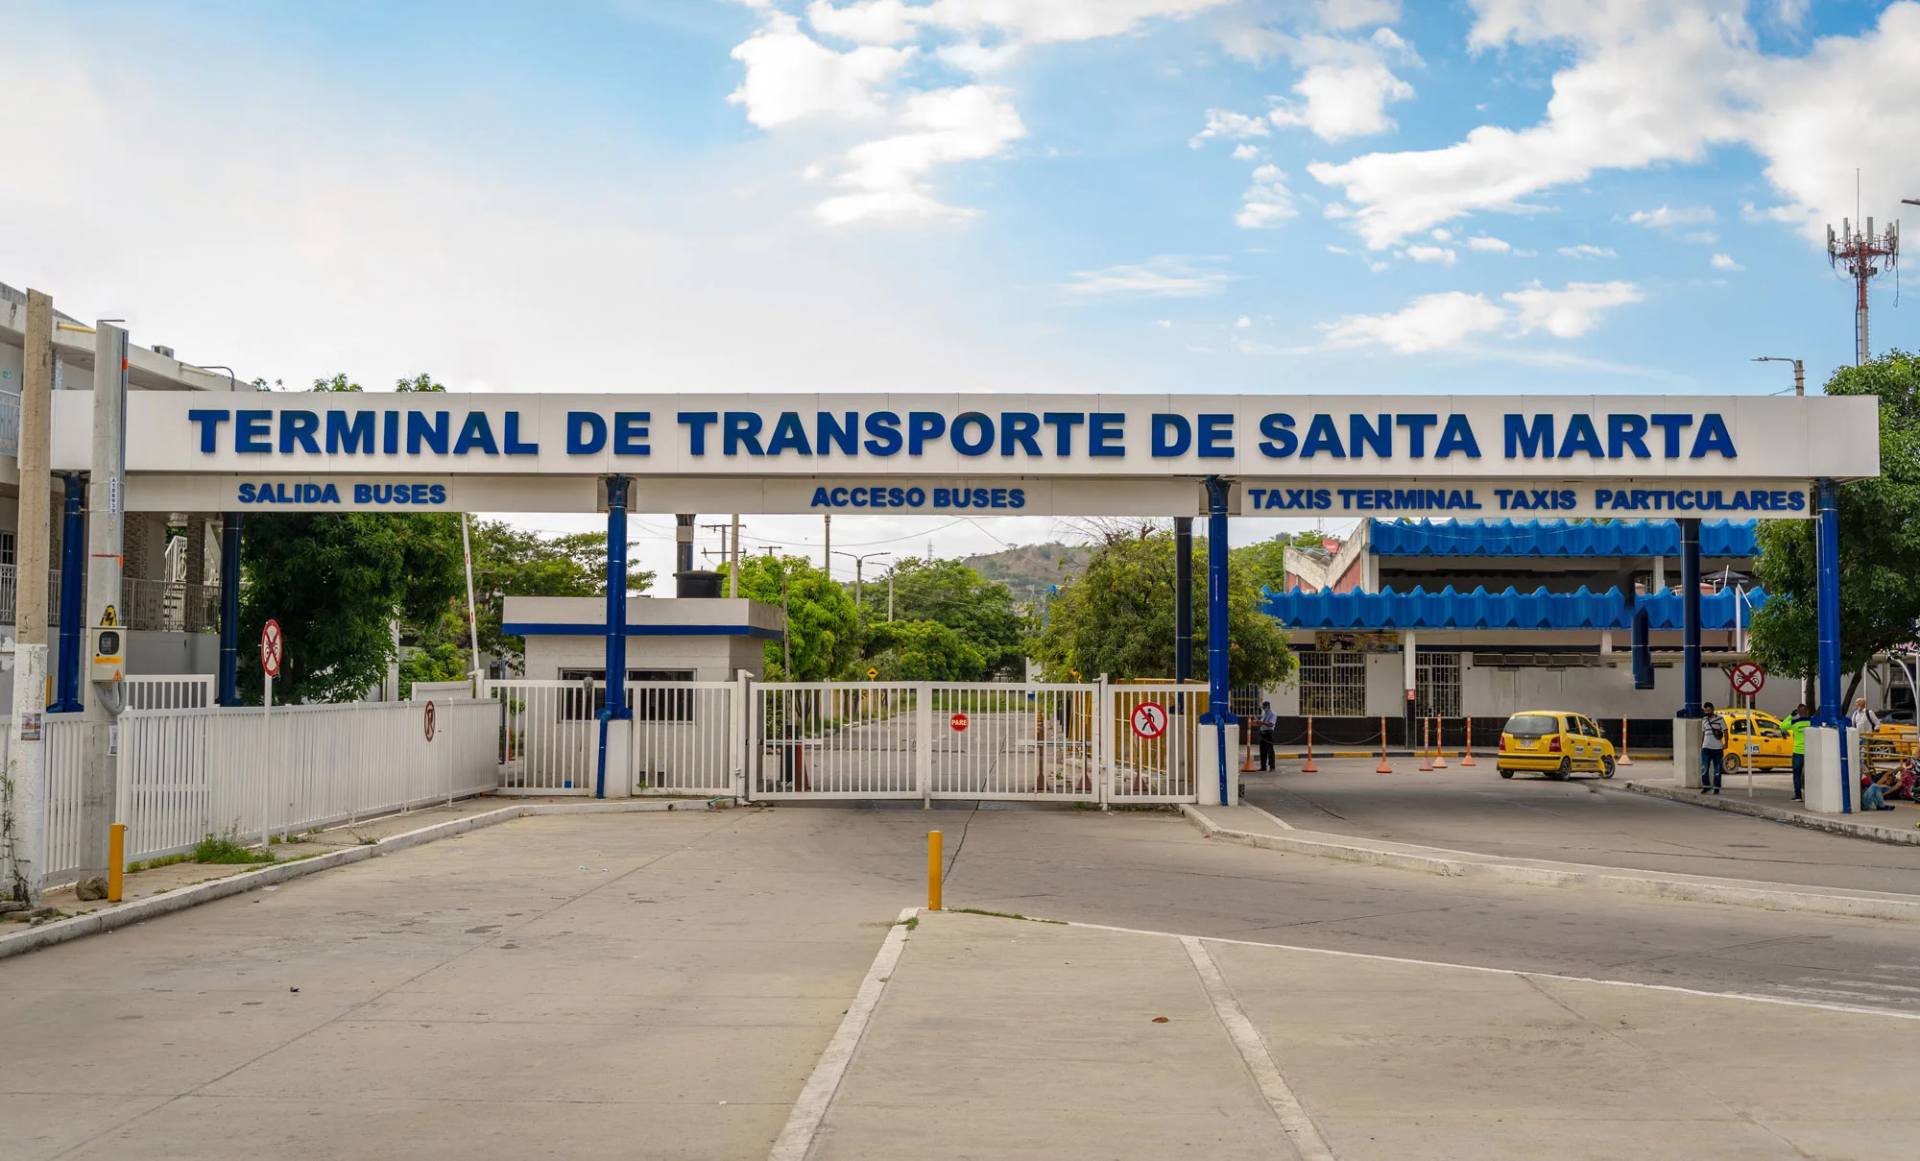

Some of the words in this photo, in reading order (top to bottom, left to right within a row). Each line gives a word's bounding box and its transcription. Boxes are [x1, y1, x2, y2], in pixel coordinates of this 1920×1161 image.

[187, 409, 539, 455] TERMINAL
[566, 411, 651, 456] DE
[677, 411, 1126, 457] TRANSPORTE
[1151, 413, 1235, 458] DE
[1259, 413, 1481, 458] SANTA
[1503, 413, 1737, 458] MARTA
[238, 483, 340, 504] SALIDA
[353, 484, 446, 505] BUSES
[811, 487, 926, 508] ACCESO
[933, 487, 1025, 508] BUSES
[1249, 488, 1332, 510] TAXIS
[1338, 488, 1481, 510] TERMINAL
[1497, 488, 1577, 510] TAXIS
[1595, 489, 1805, 511] PARTICULARES
